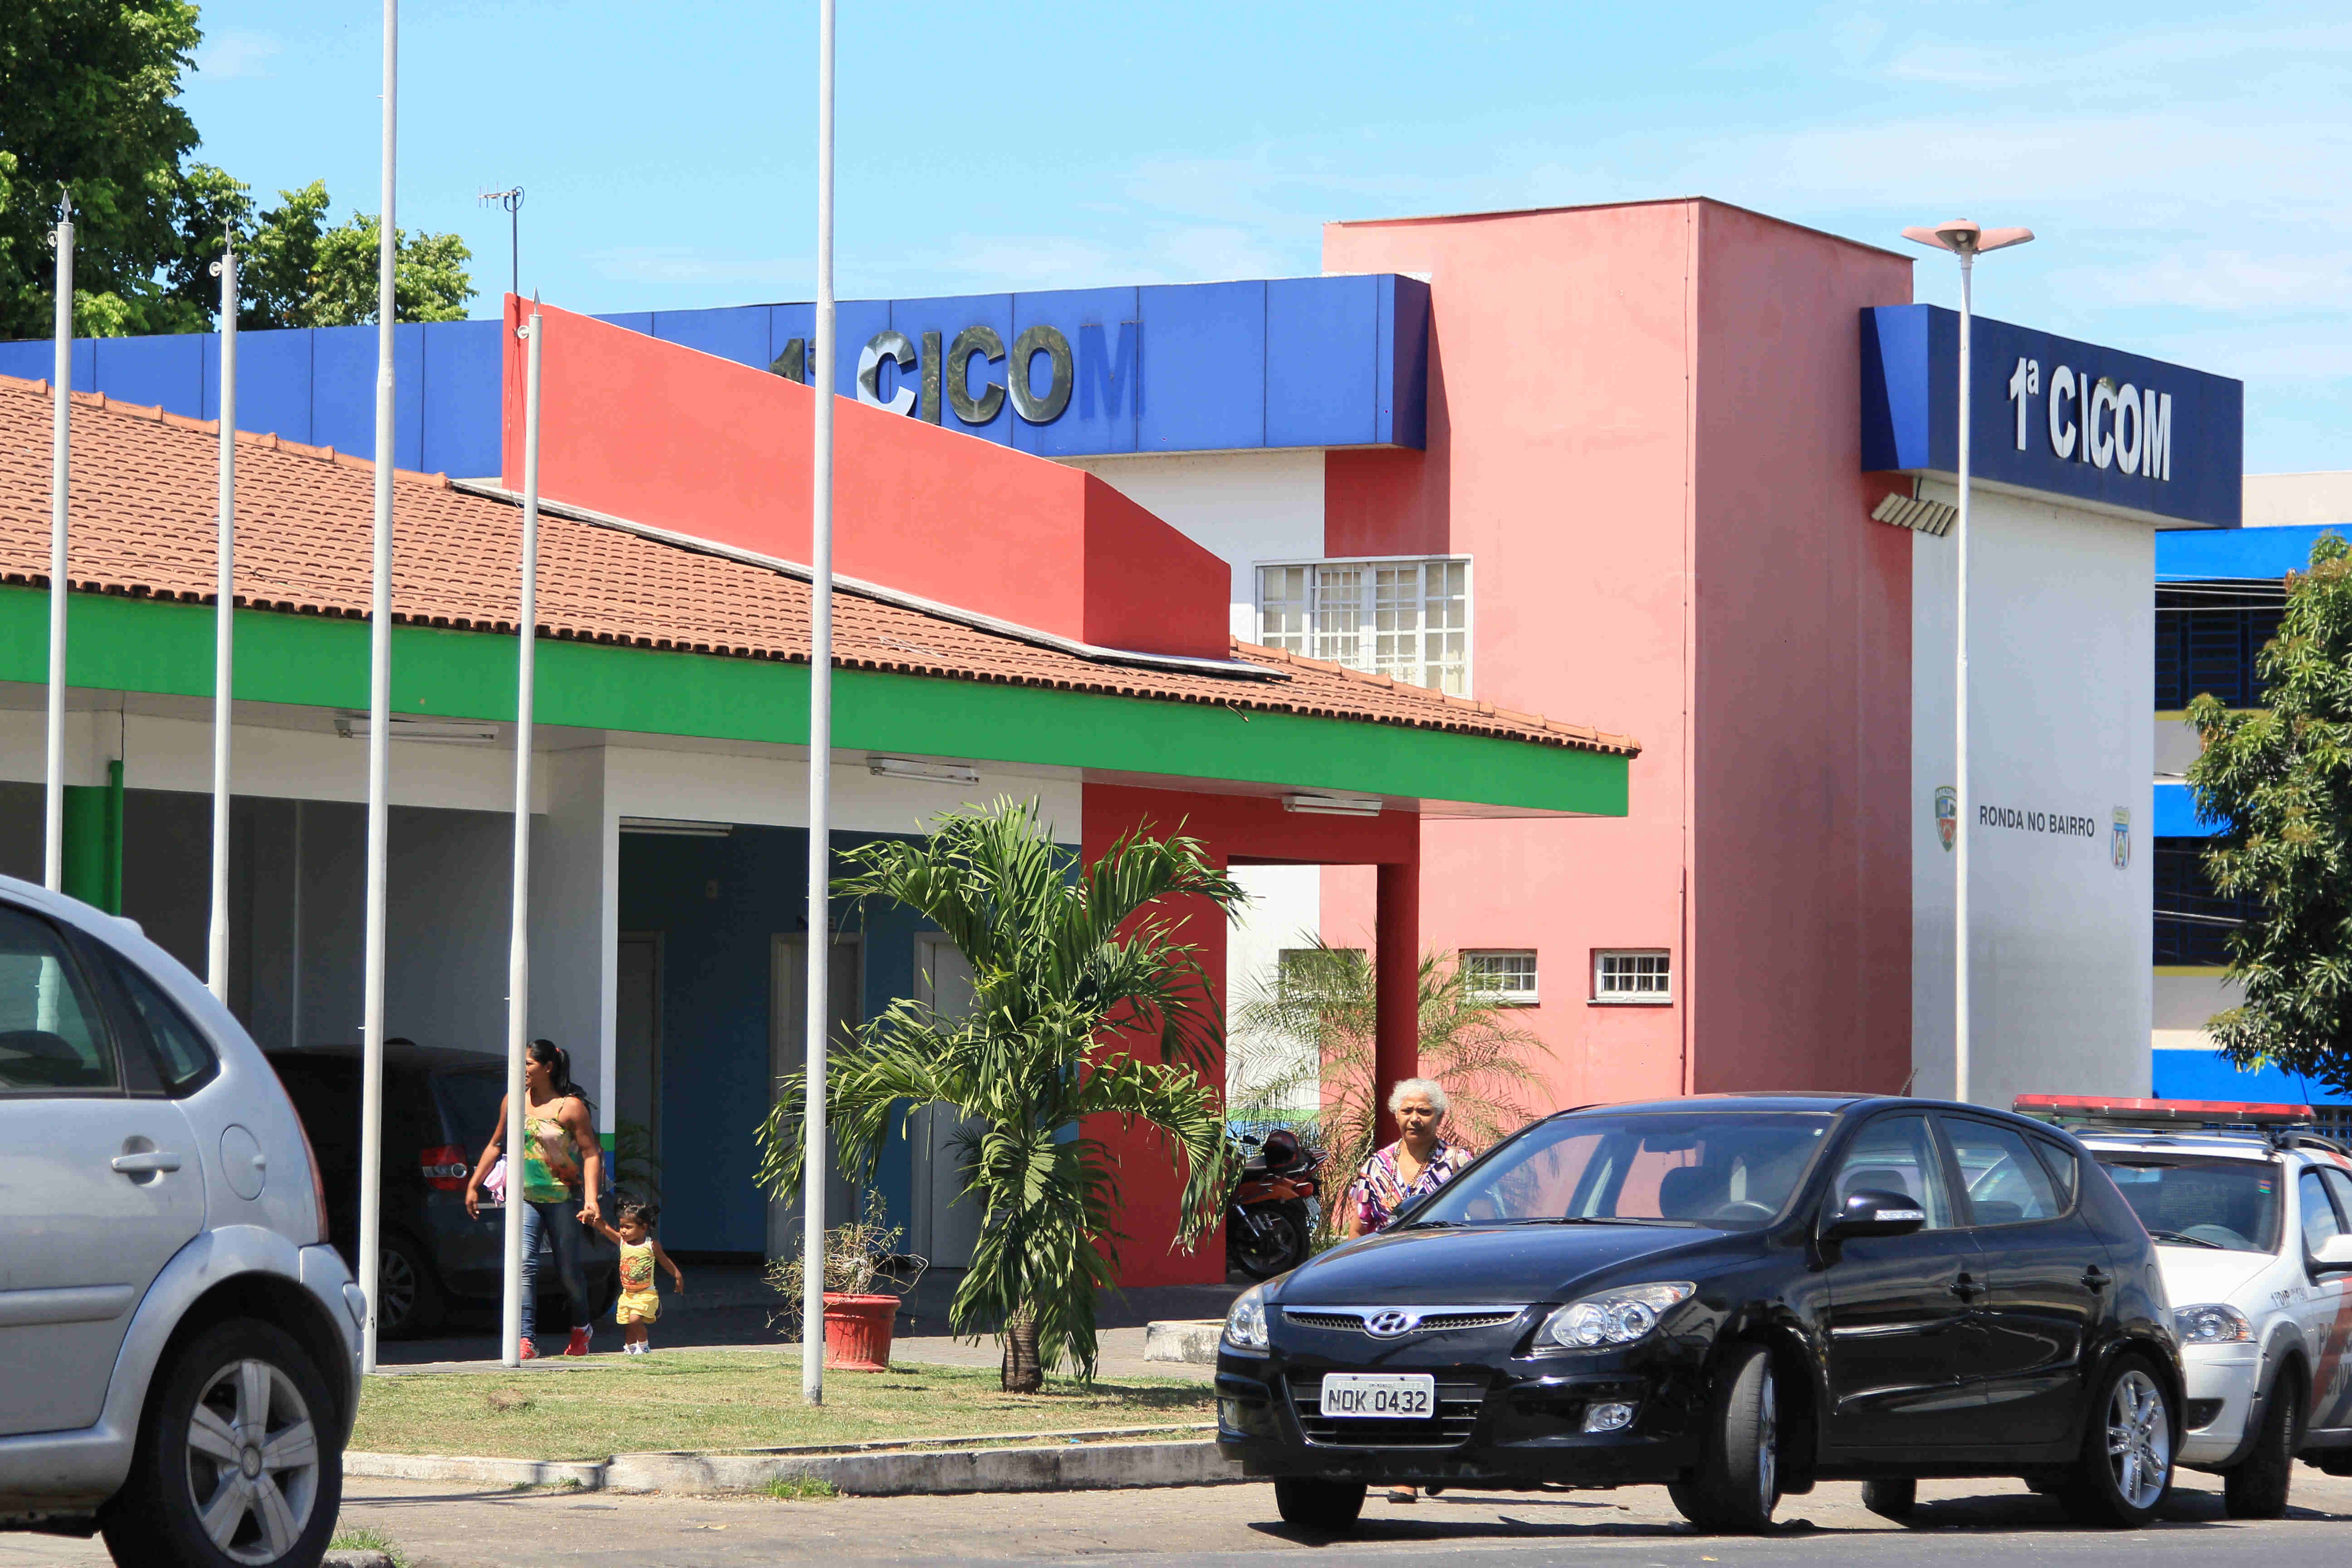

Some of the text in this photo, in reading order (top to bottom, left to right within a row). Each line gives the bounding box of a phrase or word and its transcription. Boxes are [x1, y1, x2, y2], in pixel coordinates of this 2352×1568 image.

[856, 320, 1146, 426] CICOM
[2049, 365, 2172, 482] CICOM
[1980, 805, 2024, 830] RONDA
[2028, 811, 2045, 833] NO
[2049, 814, 2095, 838] BAIRRO
[1328, 1389, 1427, 1412] NOK 0432
